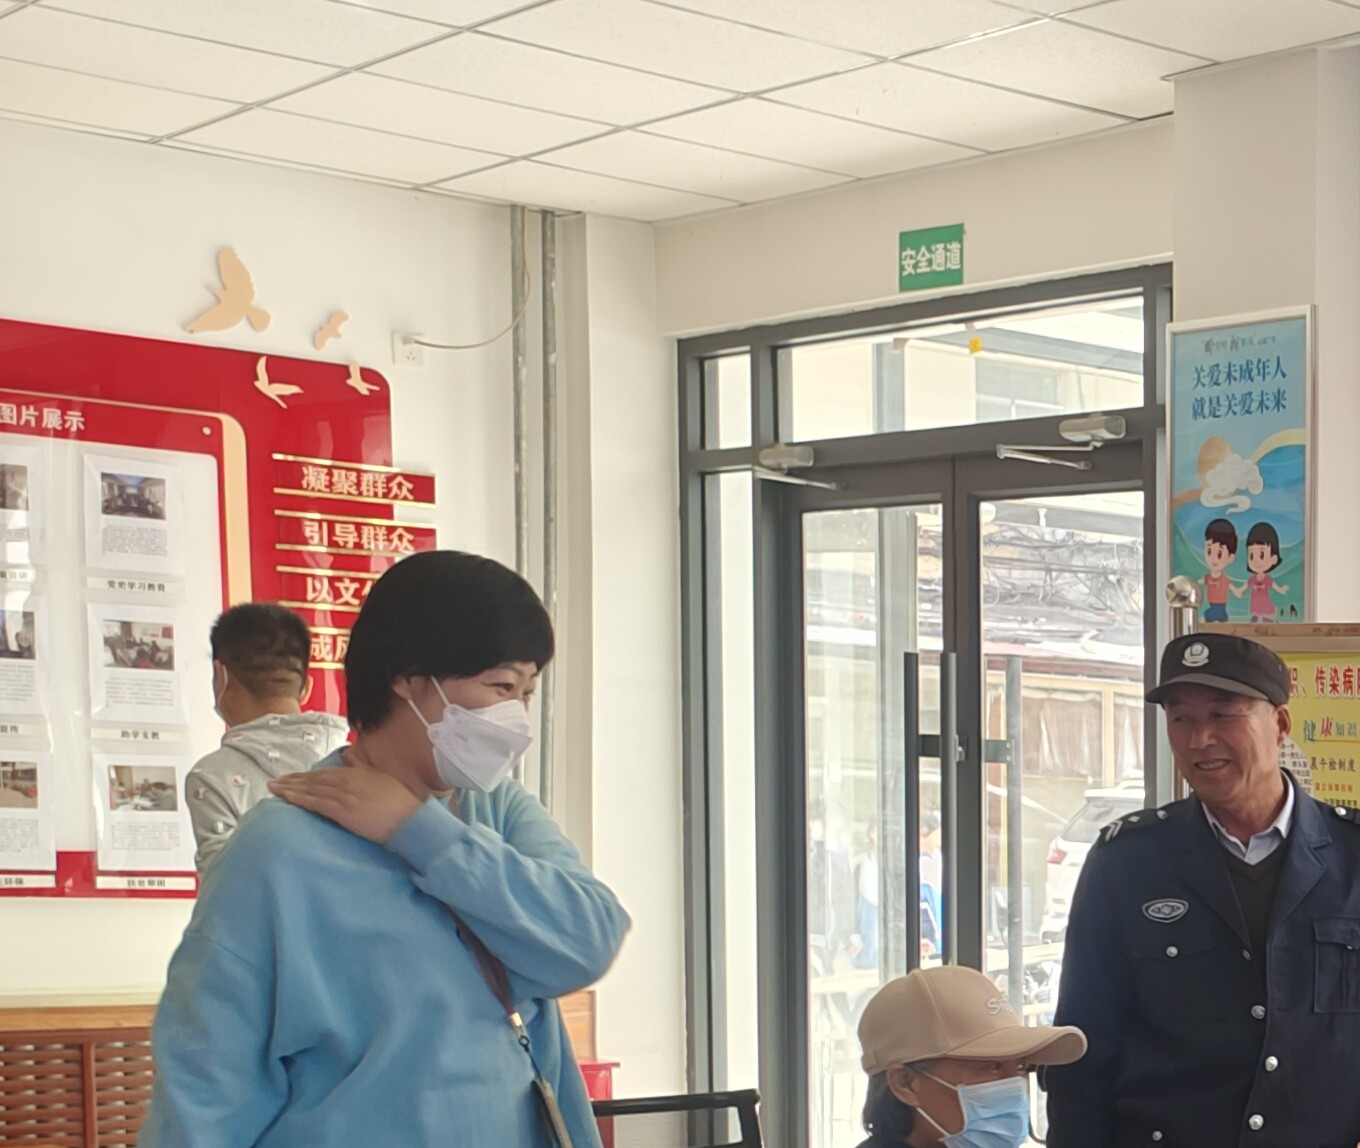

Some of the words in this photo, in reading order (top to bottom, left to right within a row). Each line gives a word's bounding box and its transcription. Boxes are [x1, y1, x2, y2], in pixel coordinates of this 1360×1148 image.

[901, 241, 961, 277] 安全通道
[1192, 355, 1288, 391] 关爱未成年人
[0, 403, 86, 432] 图片展示
[1192, 387, 1287, 421] 就是关爱未来
[302, 466, 414, 500] 凝聚群众
[303, 520, 415, 553] 引导群众
